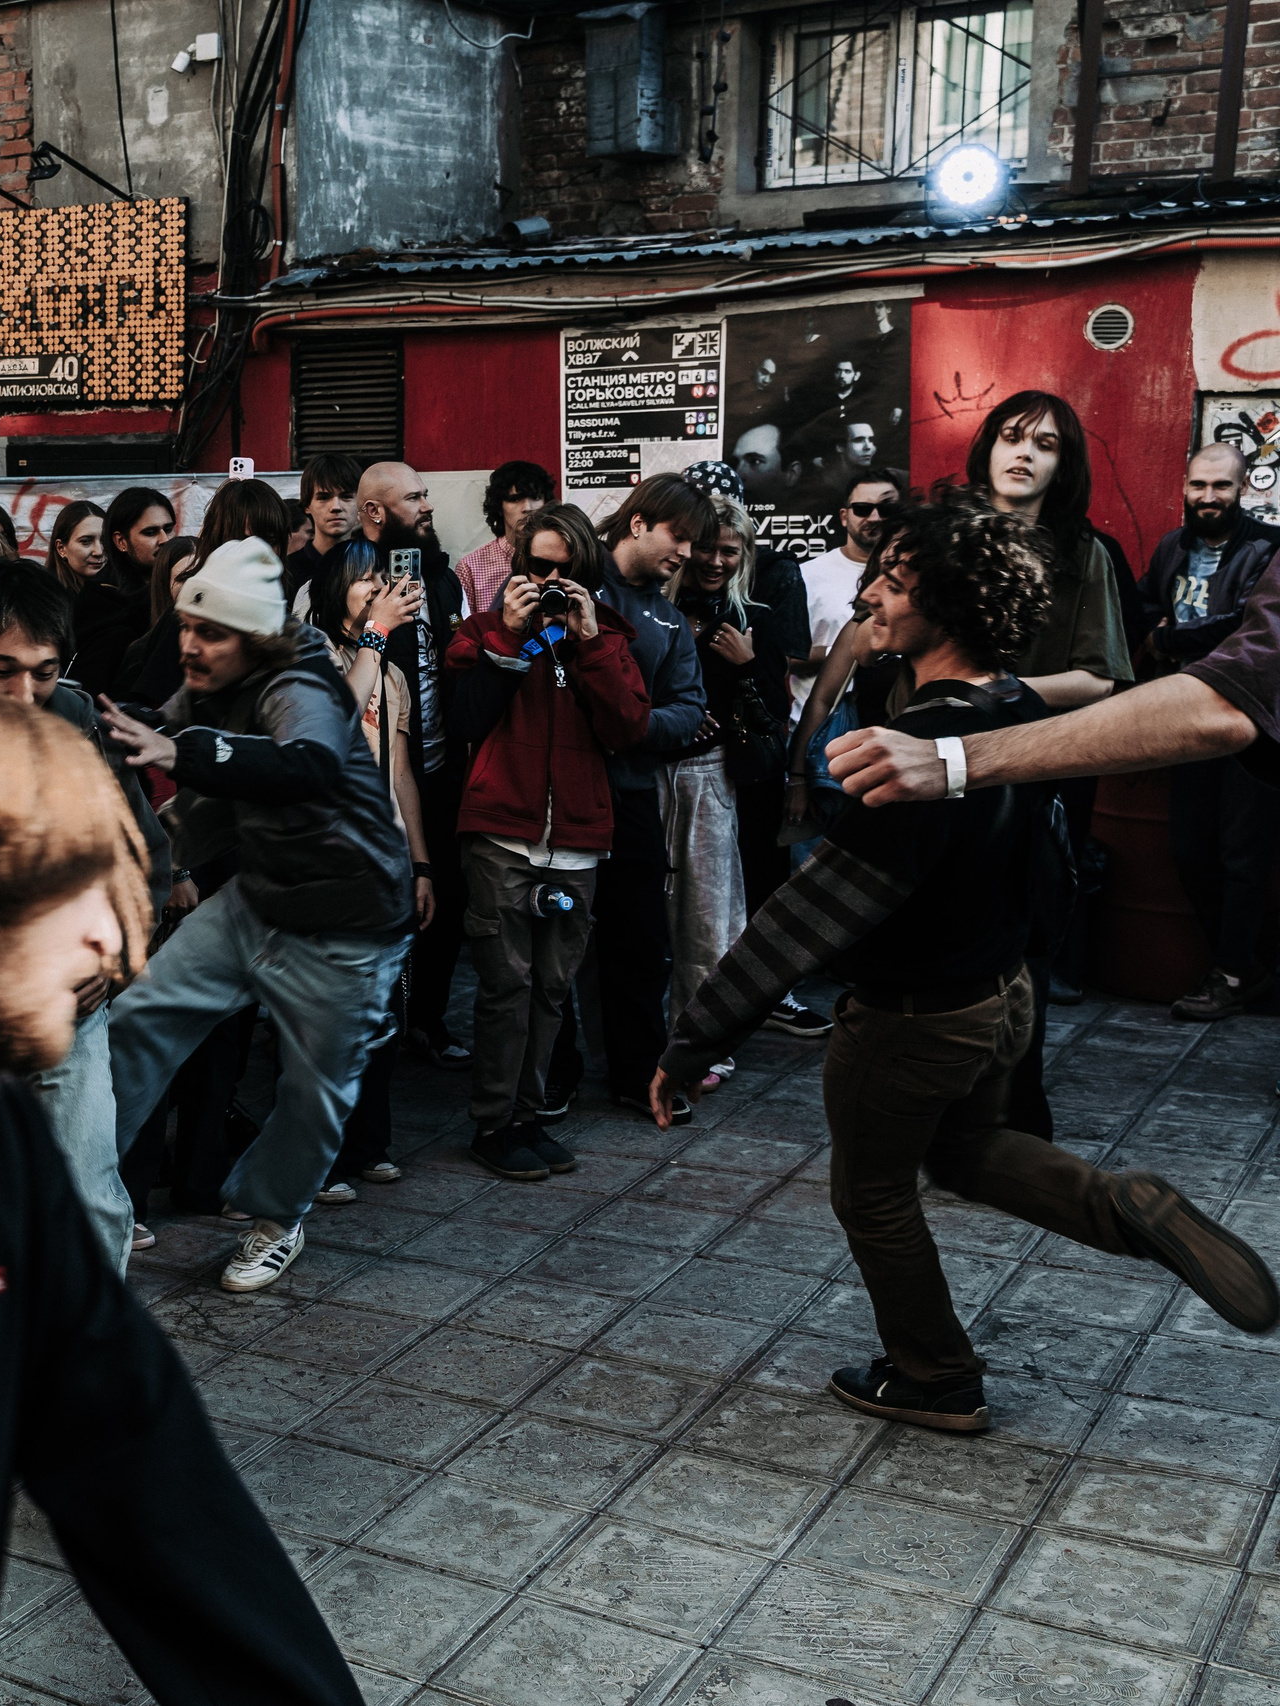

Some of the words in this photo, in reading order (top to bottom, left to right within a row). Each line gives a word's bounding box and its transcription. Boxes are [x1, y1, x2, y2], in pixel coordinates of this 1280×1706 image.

[567, 332, 640, 352] ВОЛЖСКИЙ
[49, 356, 79, 381] 40
[567, 374, 628, 388] СТАНЦИЯ
[629, 371, 676, 385] МЕТРО
[567, 384, 676, 402] ГОРЬКОВСКАЯ
[567, 417, 621, 428] BASSDUMA
[568, 459, 594, 468] 22:00
[568, 476, 590, 487] Клуб
[590, 476, 607, 484] LOT
[754, 503, 776, 511] 20:00
[749, 514, 835, 535] УБЕЖ
